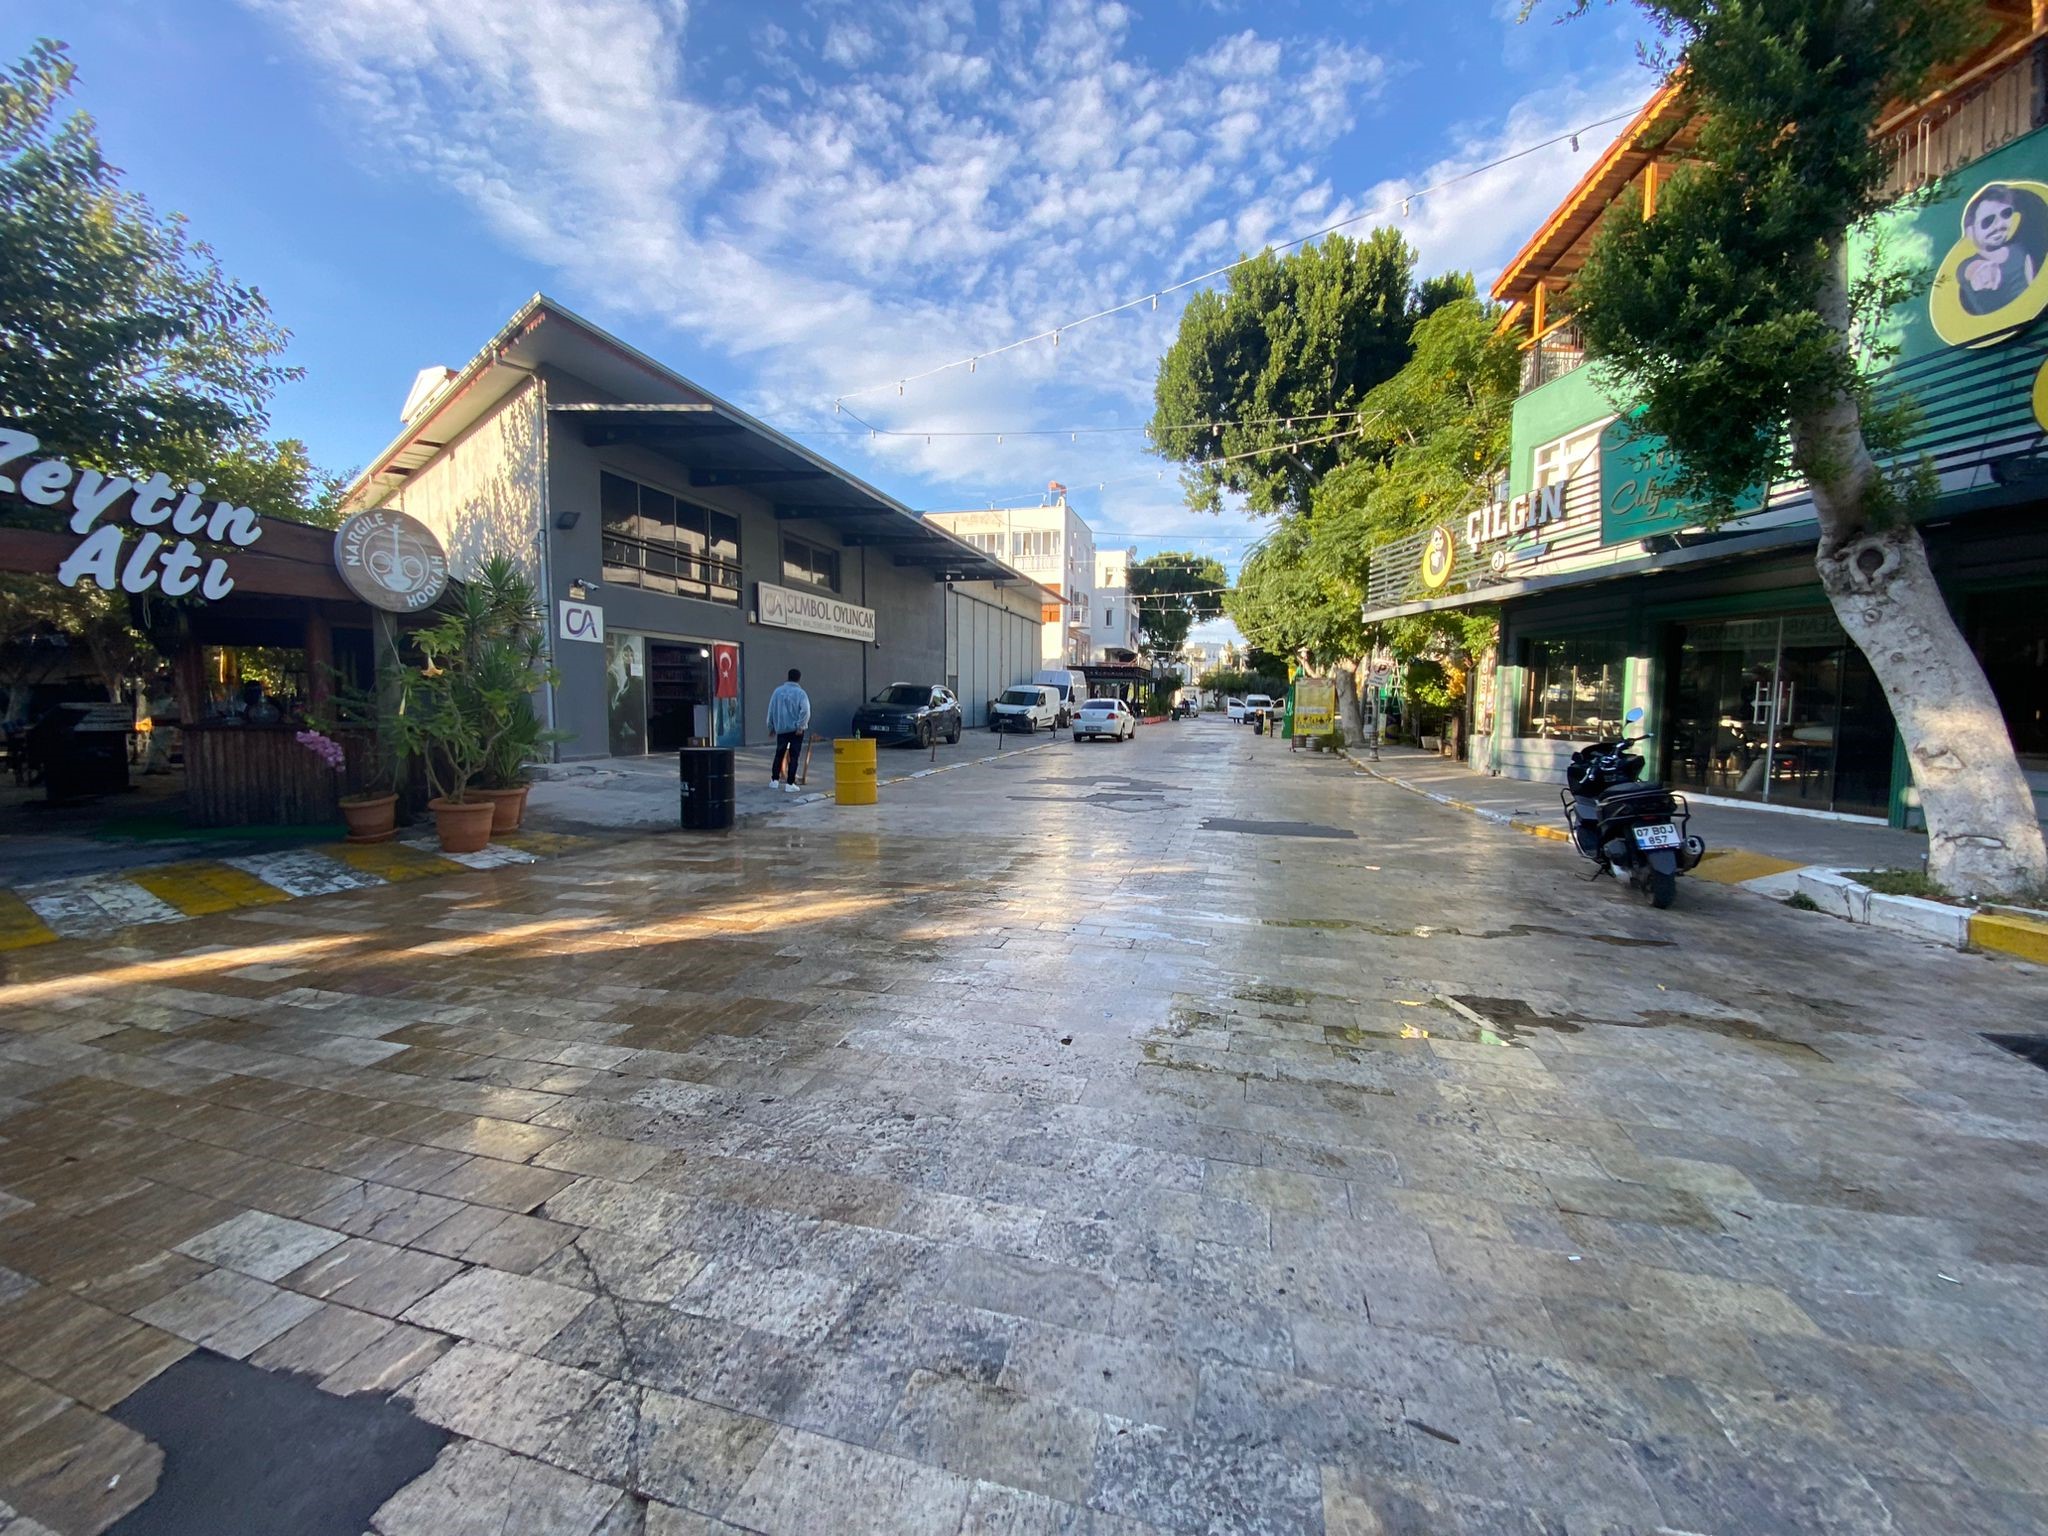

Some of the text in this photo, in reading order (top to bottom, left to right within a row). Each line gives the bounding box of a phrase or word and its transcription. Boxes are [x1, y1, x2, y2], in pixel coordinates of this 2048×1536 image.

[406, 555, 445, 608] HOOKAH
[787, 594, 874, 629] SEMBOL OYUNCAK
[1636, 829, 1648, 837] 07
[1648, 836, 1667, 844] 857
